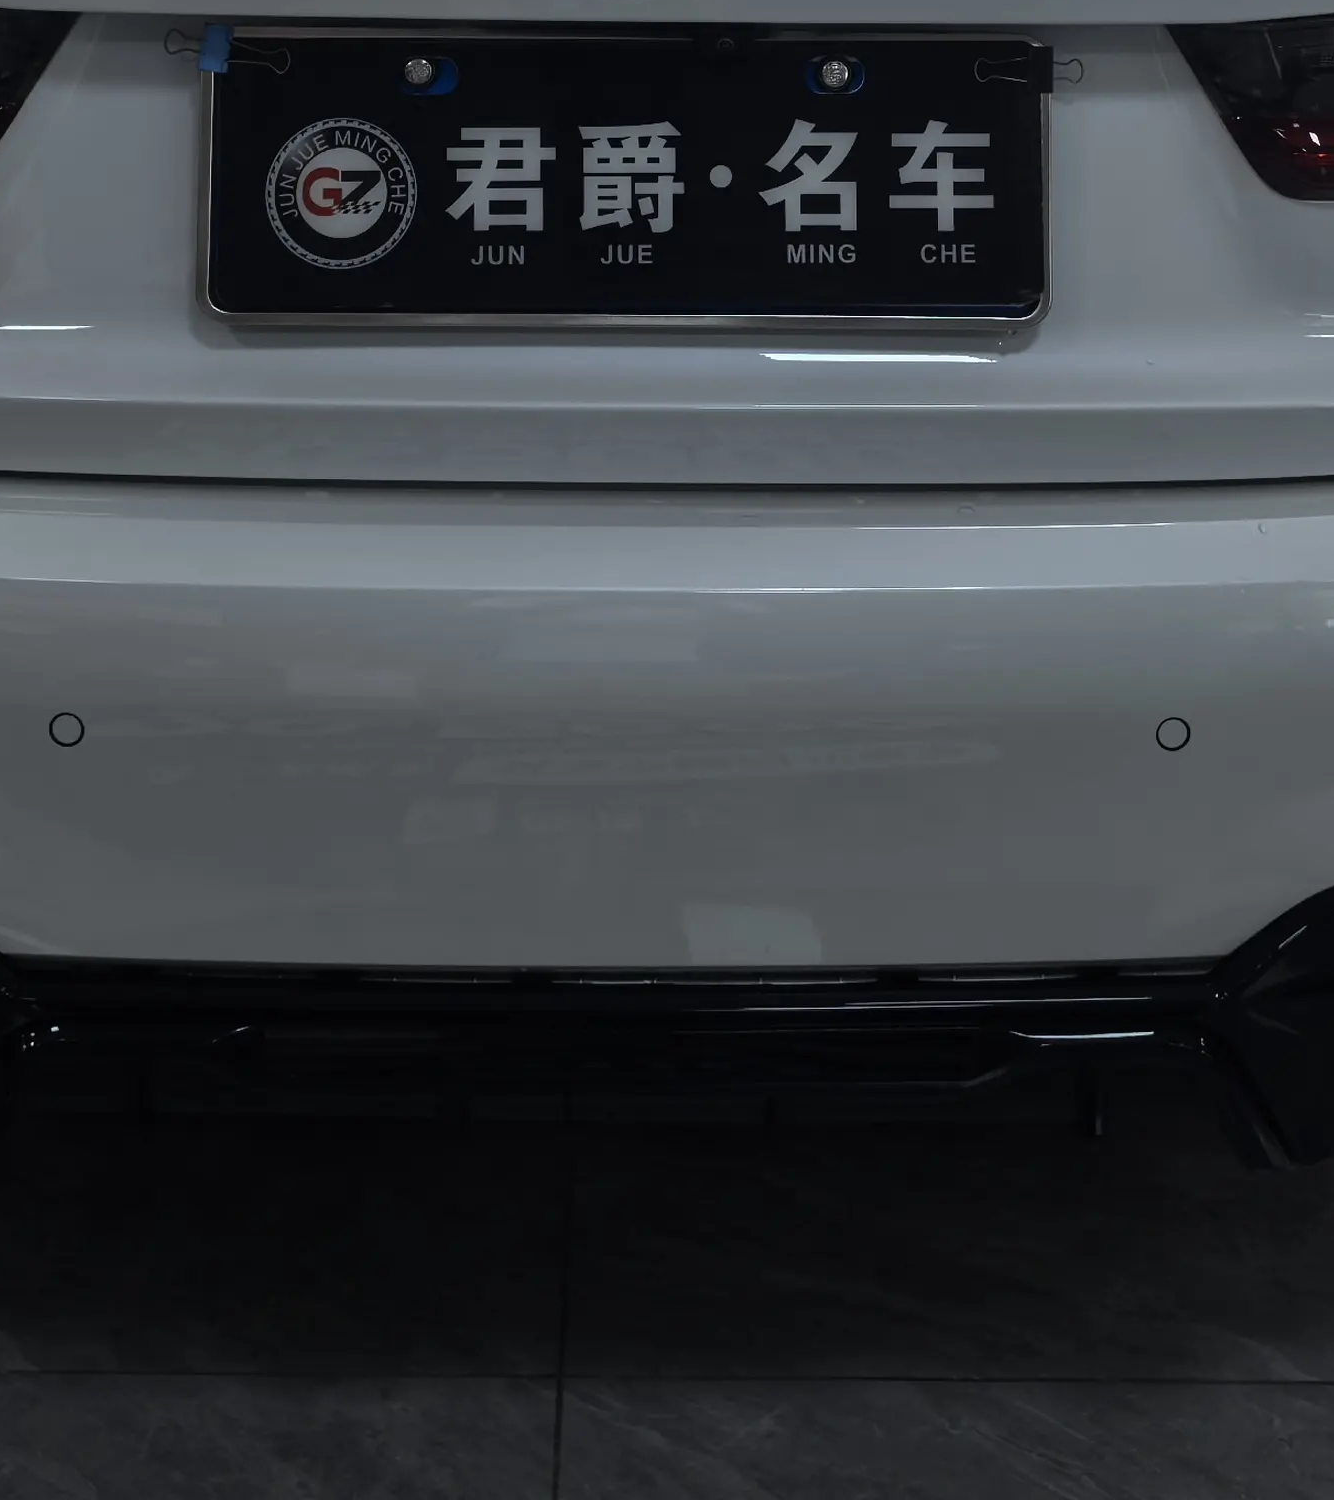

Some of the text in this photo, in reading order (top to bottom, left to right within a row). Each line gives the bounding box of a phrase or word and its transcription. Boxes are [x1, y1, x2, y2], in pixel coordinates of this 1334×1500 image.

[278, 130, 407, 218] JUN JUE MING CHE
[470, 243, 978, 266] JUN JUE MING CHE
